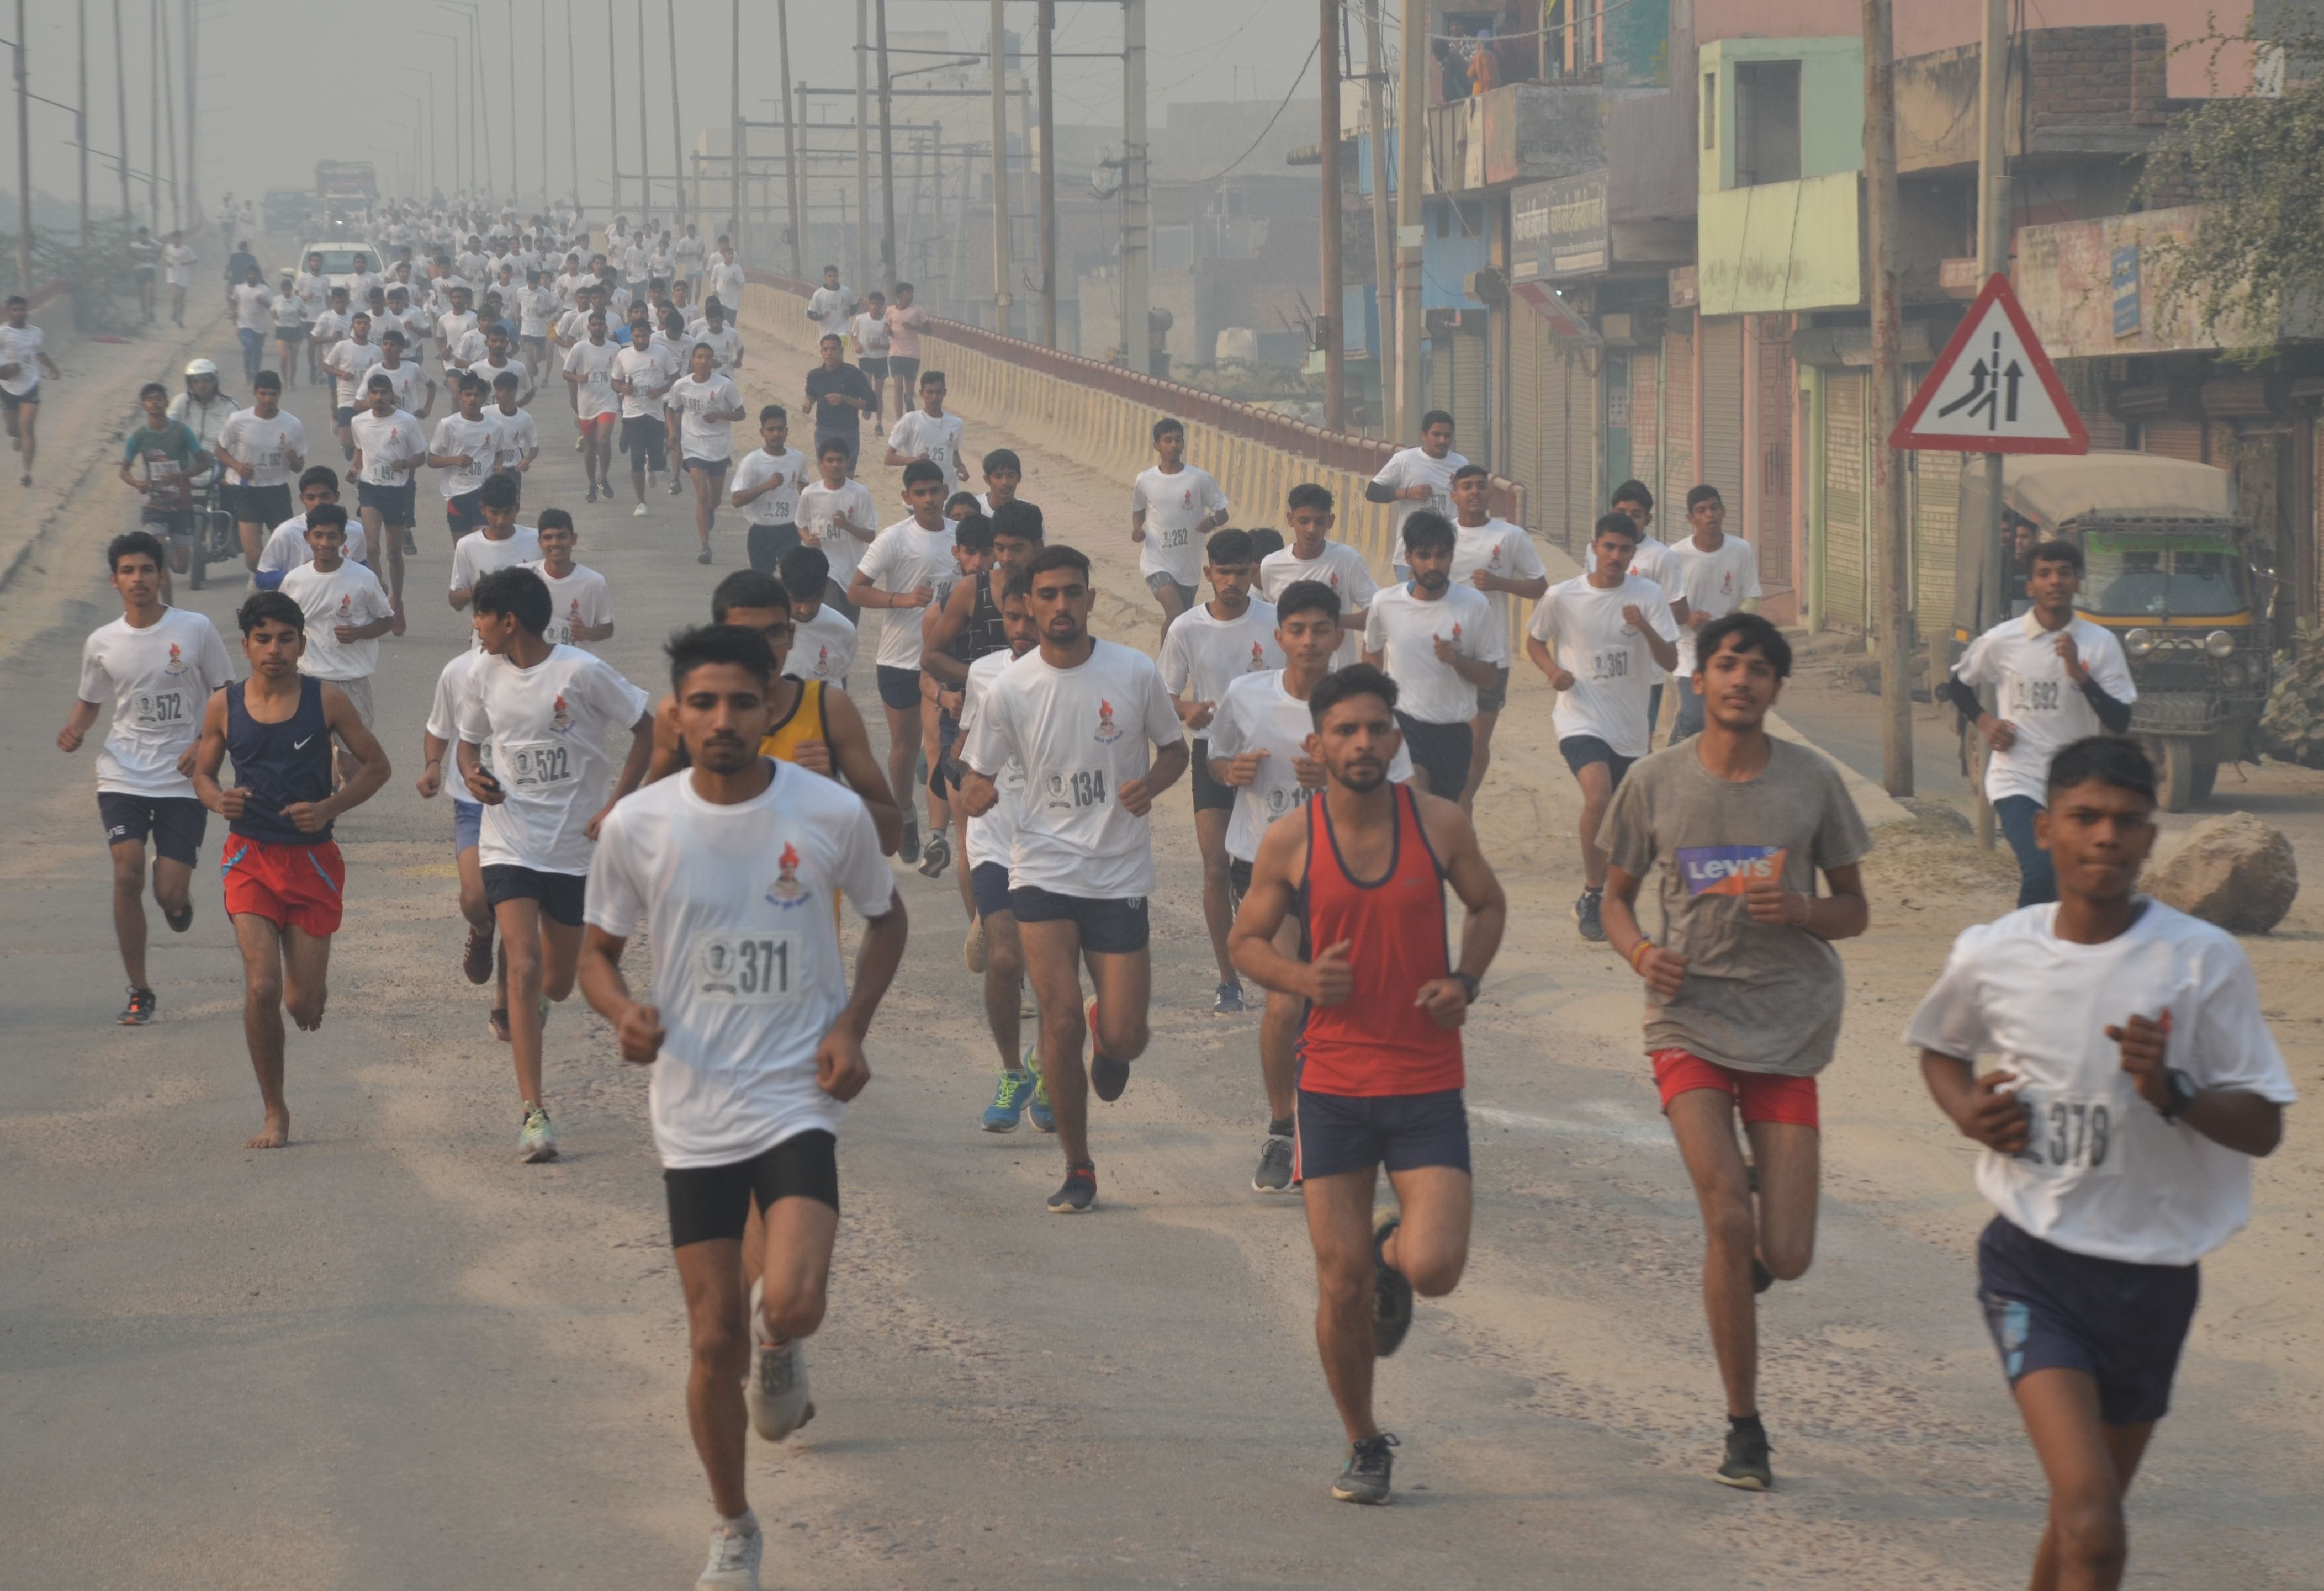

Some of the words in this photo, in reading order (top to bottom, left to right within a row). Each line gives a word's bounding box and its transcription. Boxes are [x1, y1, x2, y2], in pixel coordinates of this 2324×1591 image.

[1172, 528, 1188, 546] 252
[157, 692, 182, 721] 572
[535, 747, 570, 782] 522
[1070, 769, 1105, 807] 134
[739, 940, 787, 993] 371
